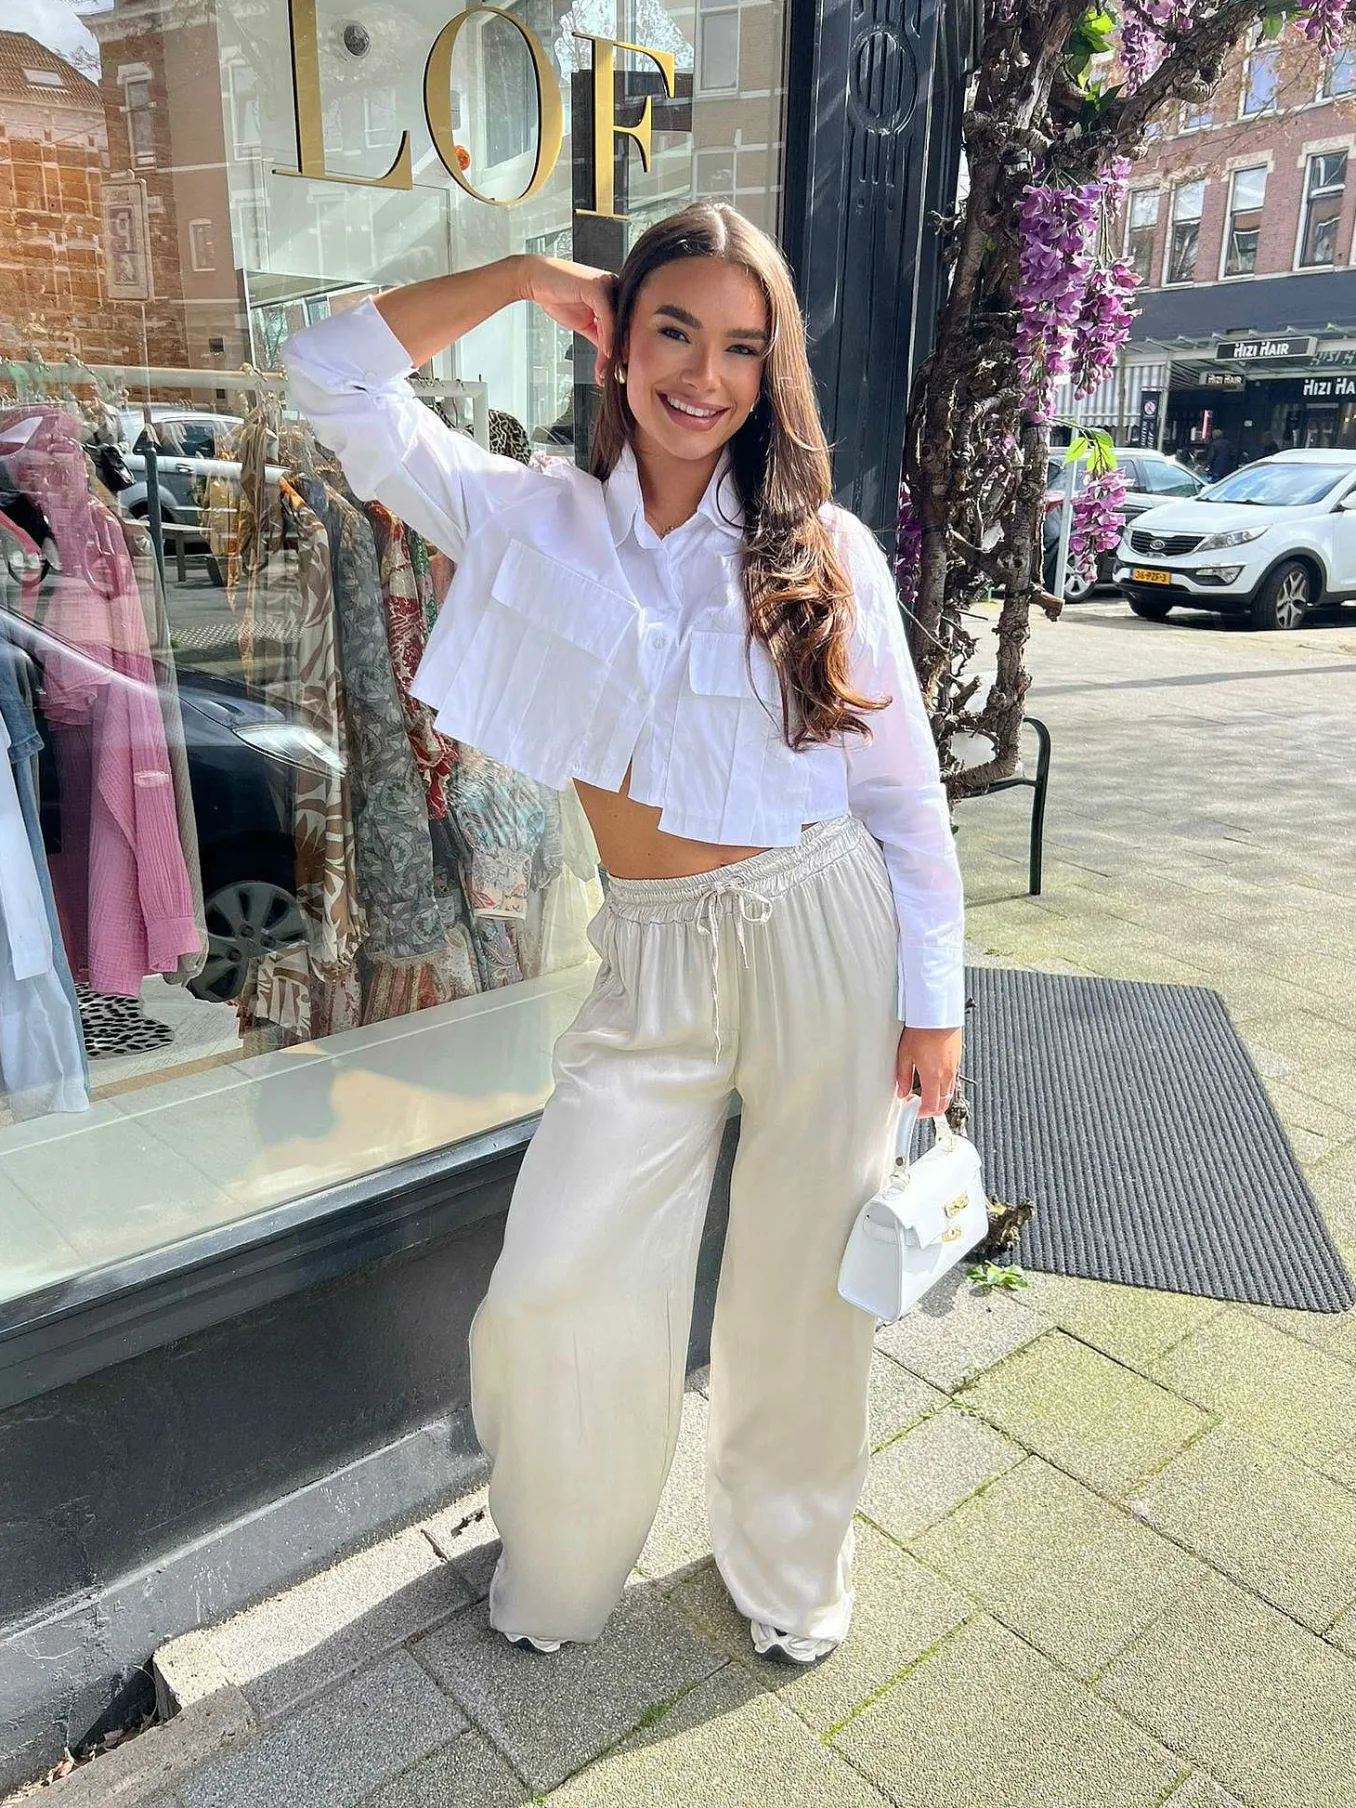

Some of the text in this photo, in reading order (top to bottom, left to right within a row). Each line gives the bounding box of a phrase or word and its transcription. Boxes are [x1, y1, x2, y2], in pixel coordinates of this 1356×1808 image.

[272, 0, 676, 220] LOF
[1233, 341, 1289, 357] HIZI HAIR
[1303, 379, 1332, 396] HIZI
